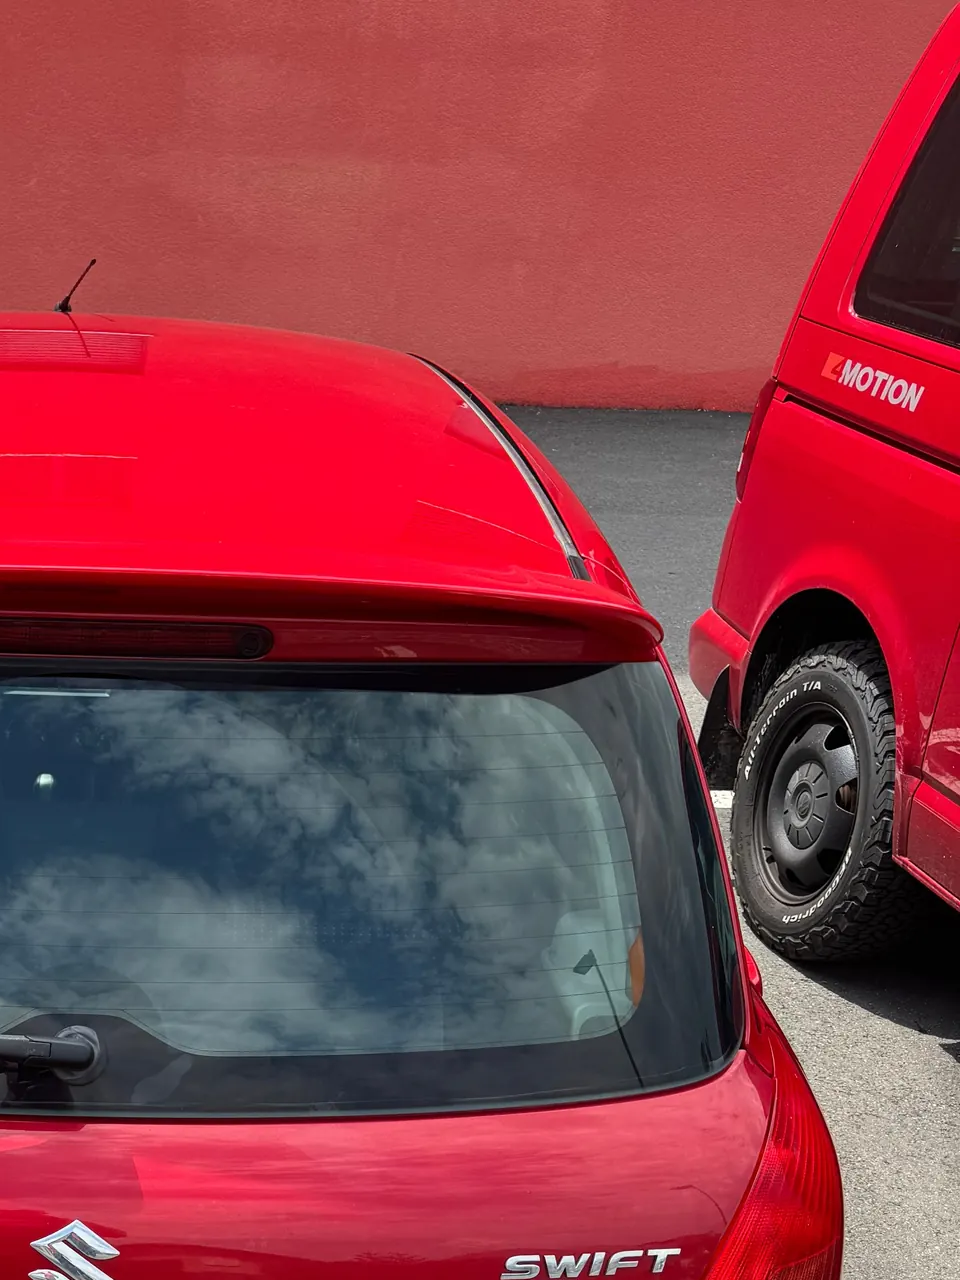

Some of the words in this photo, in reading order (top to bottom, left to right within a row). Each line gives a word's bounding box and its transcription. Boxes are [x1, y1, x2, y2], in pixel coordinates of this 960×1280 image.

[821, 352, 925, 412] 4MOTION
[744, 688, 797, 780] All-Terrain
[802, 681, 821, 692] T/A
[782, 846, 852, 924] BFGoodrich
[500, 1248, 681, 1280] SWIFT
